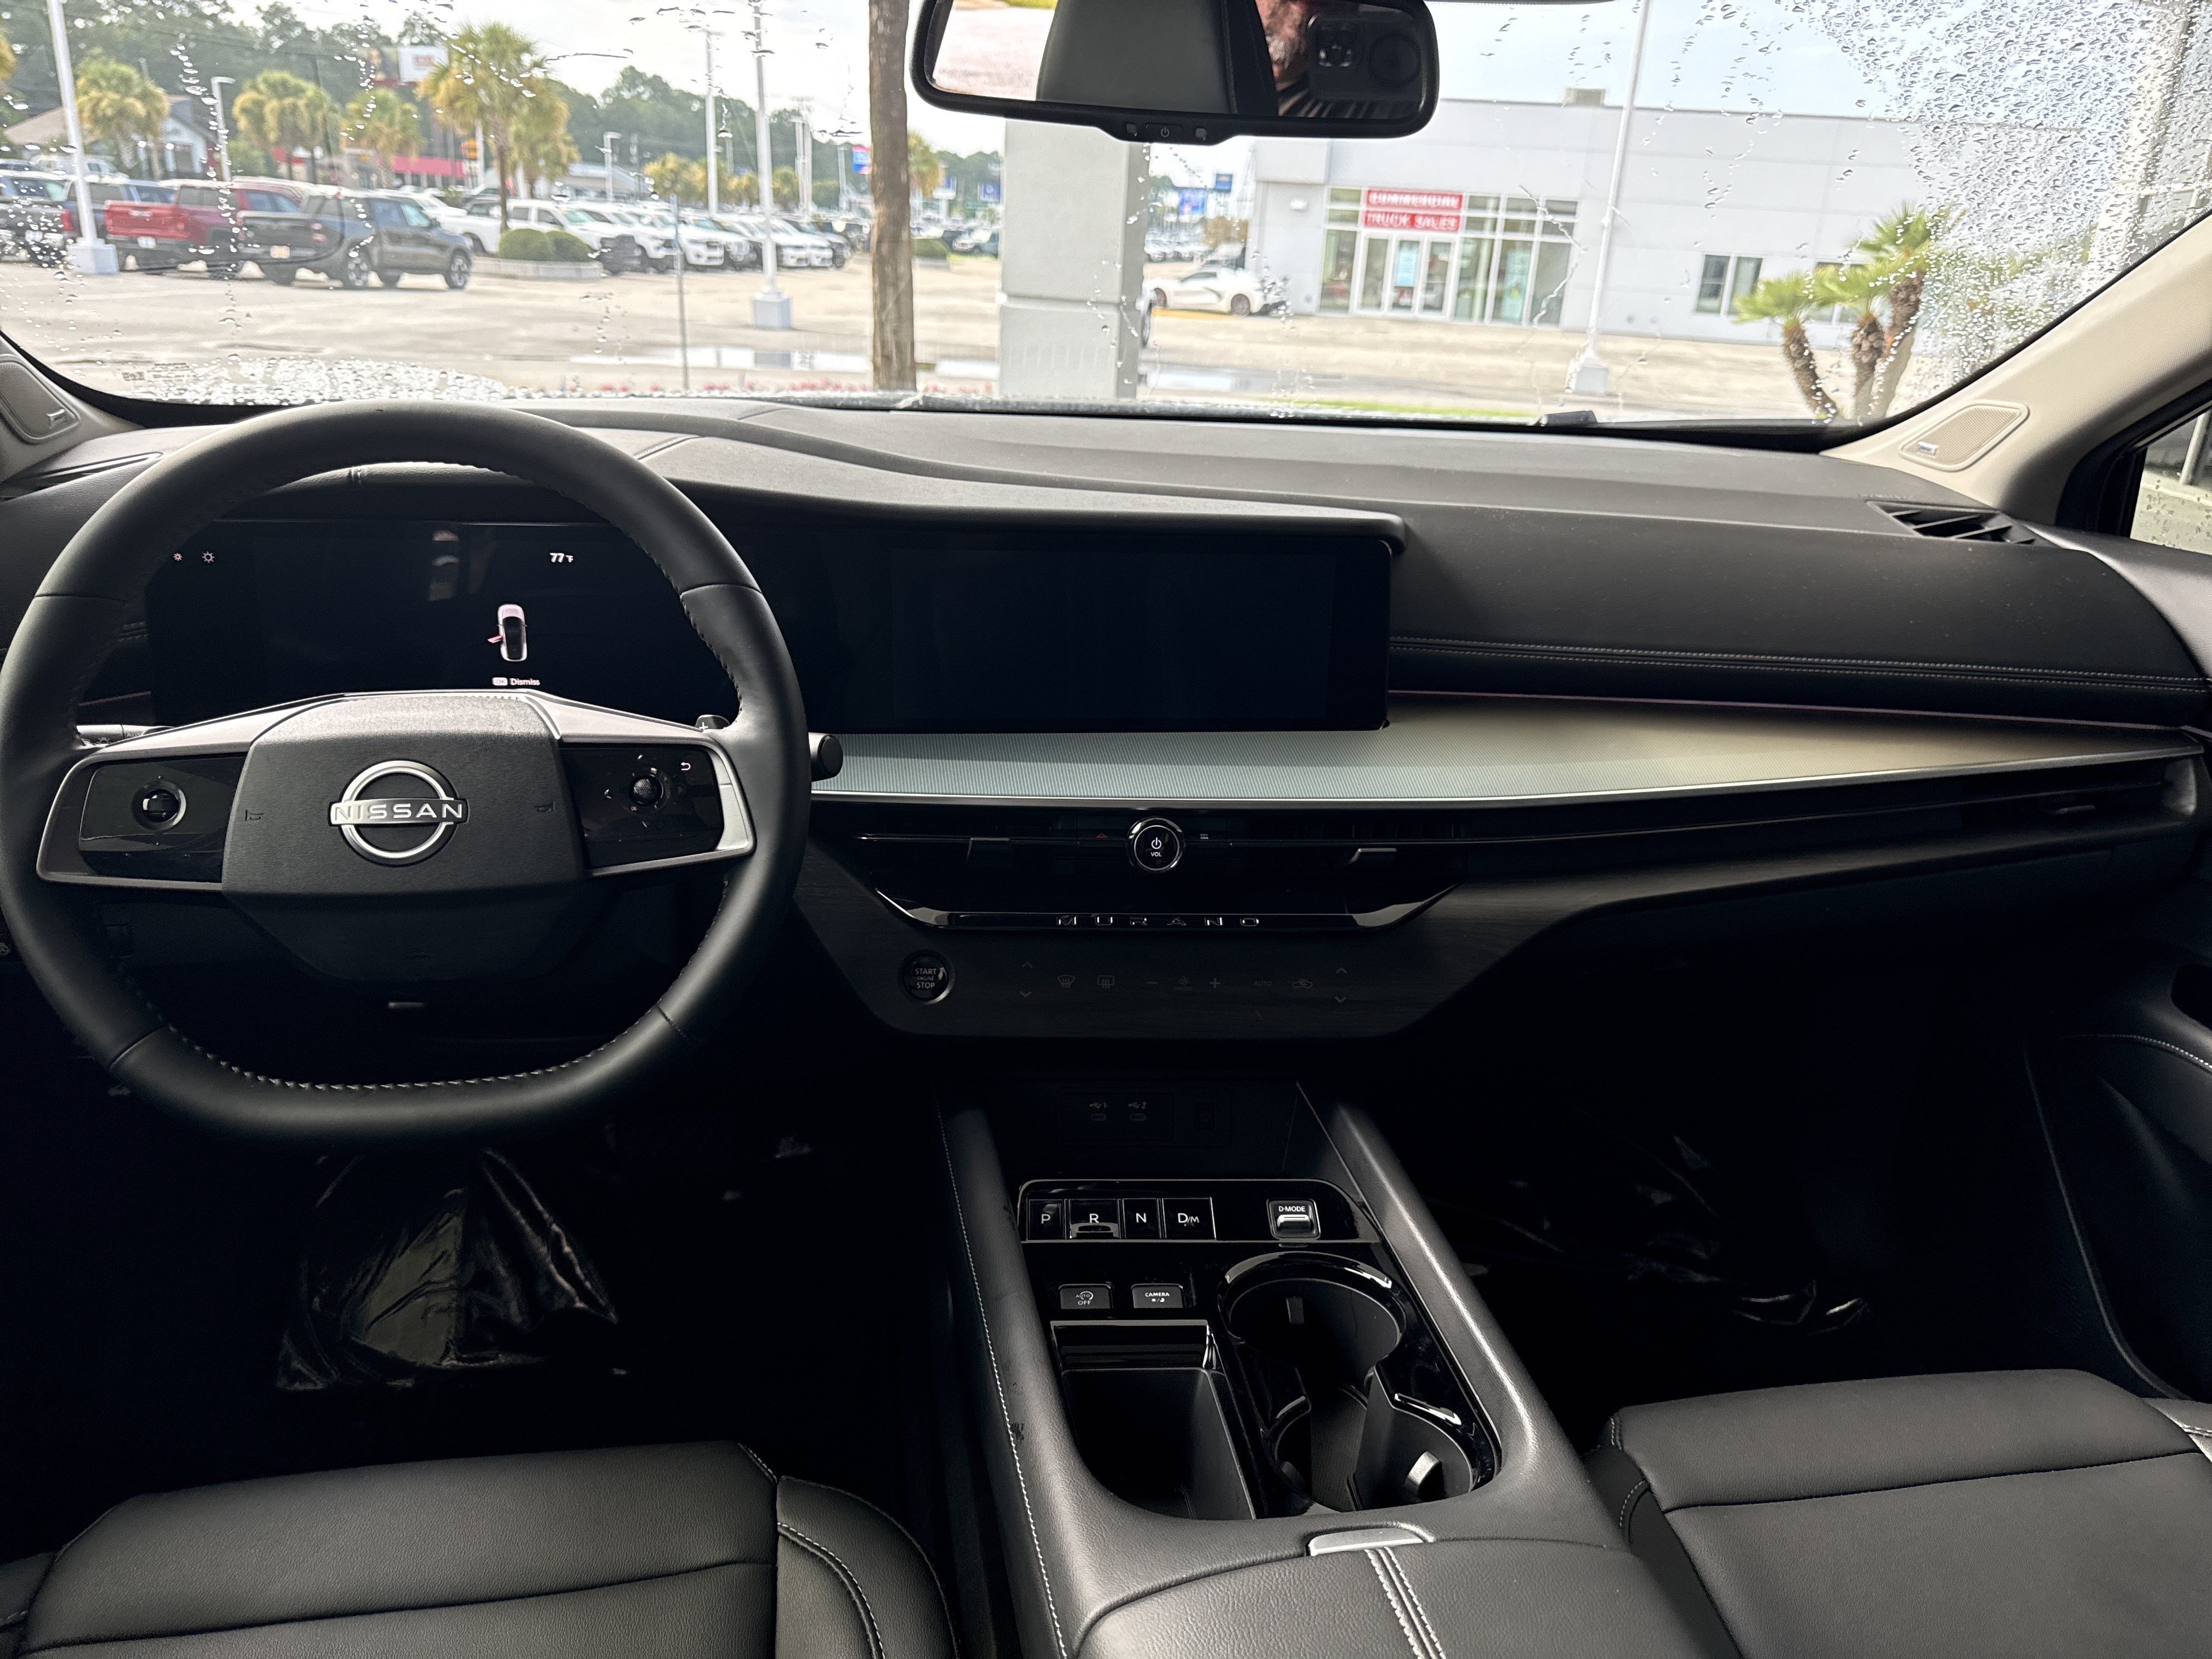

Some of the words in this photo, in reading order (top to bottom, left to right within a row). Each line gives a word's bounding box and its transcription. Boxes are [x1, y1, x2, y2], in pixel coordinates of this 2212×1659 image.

[1367, 212, 1409, 228] TRUCK
[1414, 215, 1457, 231] SALES
[510, 678, 540, 686] Dismiss
[334, 803, 463, 822] NISSAN
[1056, 915, 1260, 927] MURANO
[1041, 1214, 1051, 1224] P
[1089, 1213, 1100, 1224] R
[1136, 1212, 1147, 1223] N
